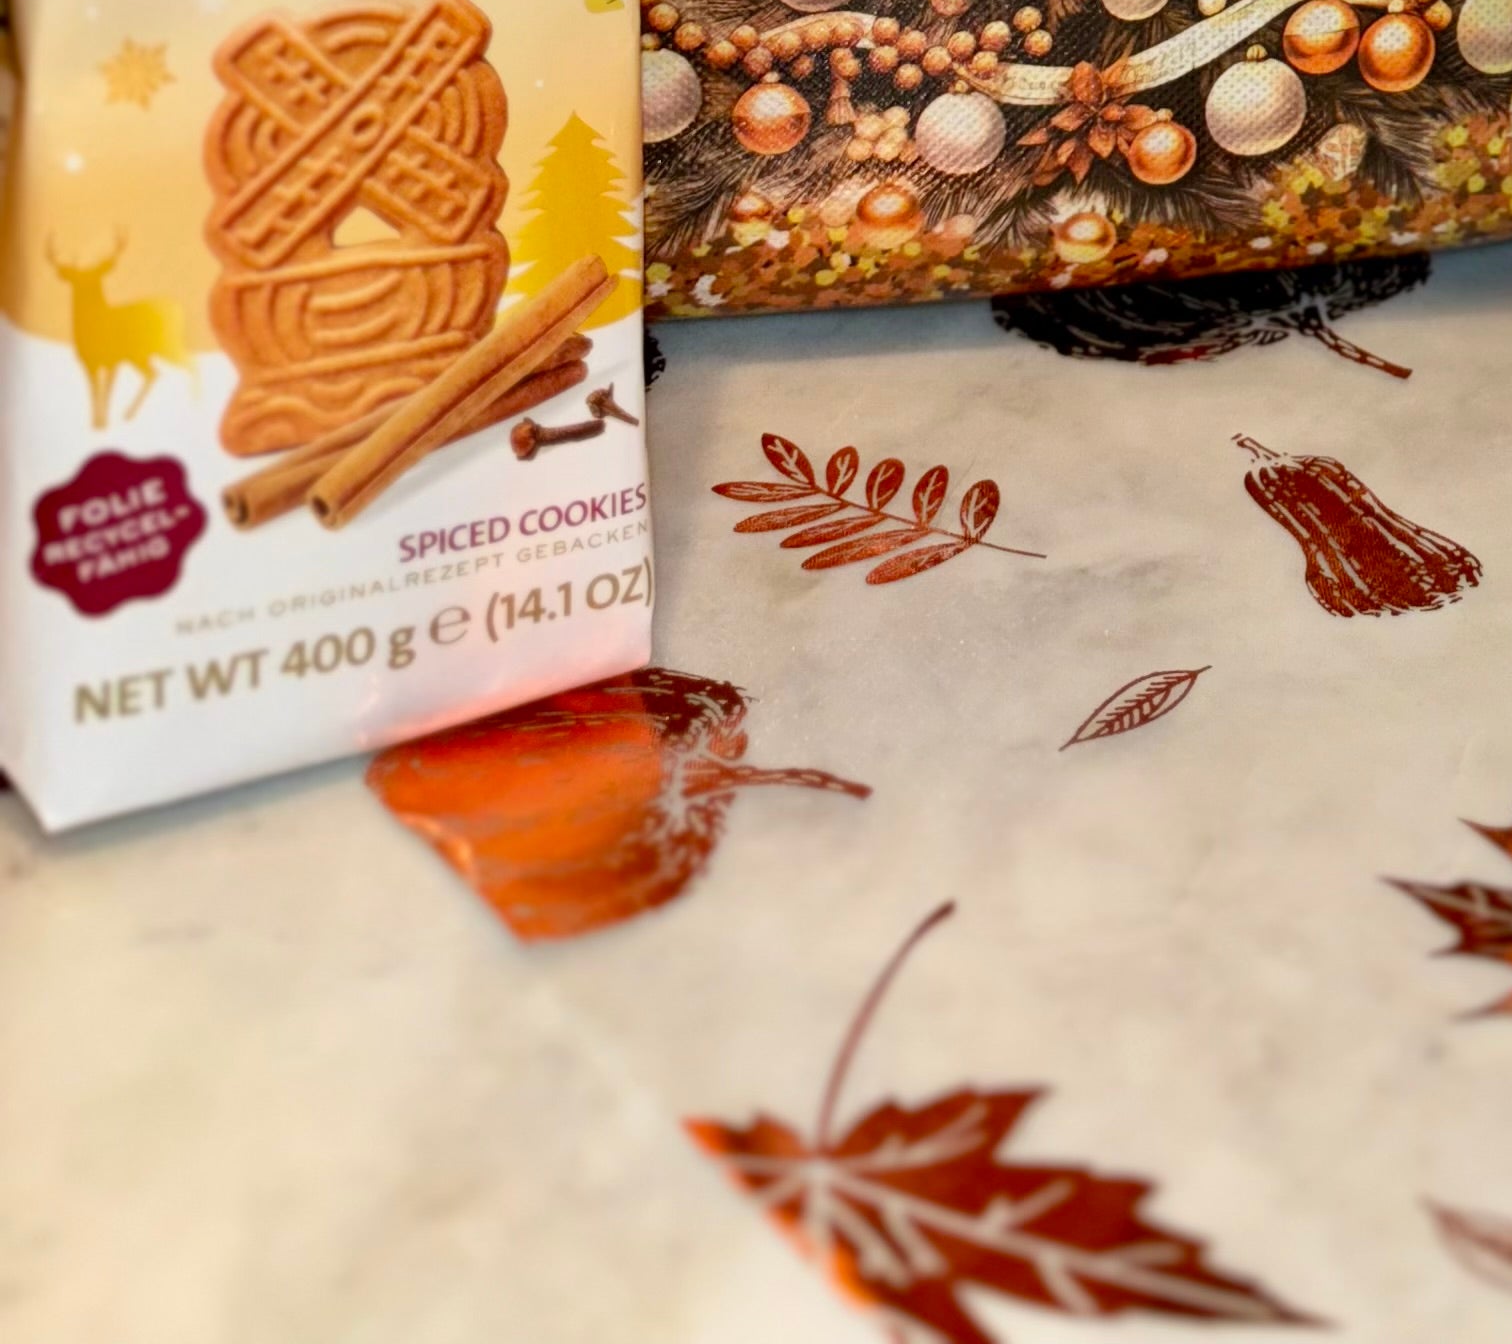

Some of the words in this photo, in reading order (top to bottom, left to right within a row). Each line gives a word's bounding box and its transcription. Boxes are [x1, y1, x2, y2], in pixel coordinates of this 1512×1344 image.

[57, 476, 168, 534] FOLIE
[398, 515, 511, 564] SPICED
[518, 483, 647, 537] COOKIES
[174, 605, 256, 636] NACH
[266, 552, 505, 619] ORIGINALREZEPT
[516, 519, 649, 564] GEBACKEN
[72, 669, 174, 724] NET
[186, 648, 270, 702] WT
[280, 626, 375, 680] 400
[387, 624, 416, 670] g
[487, 580, 573, 642] (14.1
[585, 556, 653, 610] OZ)
